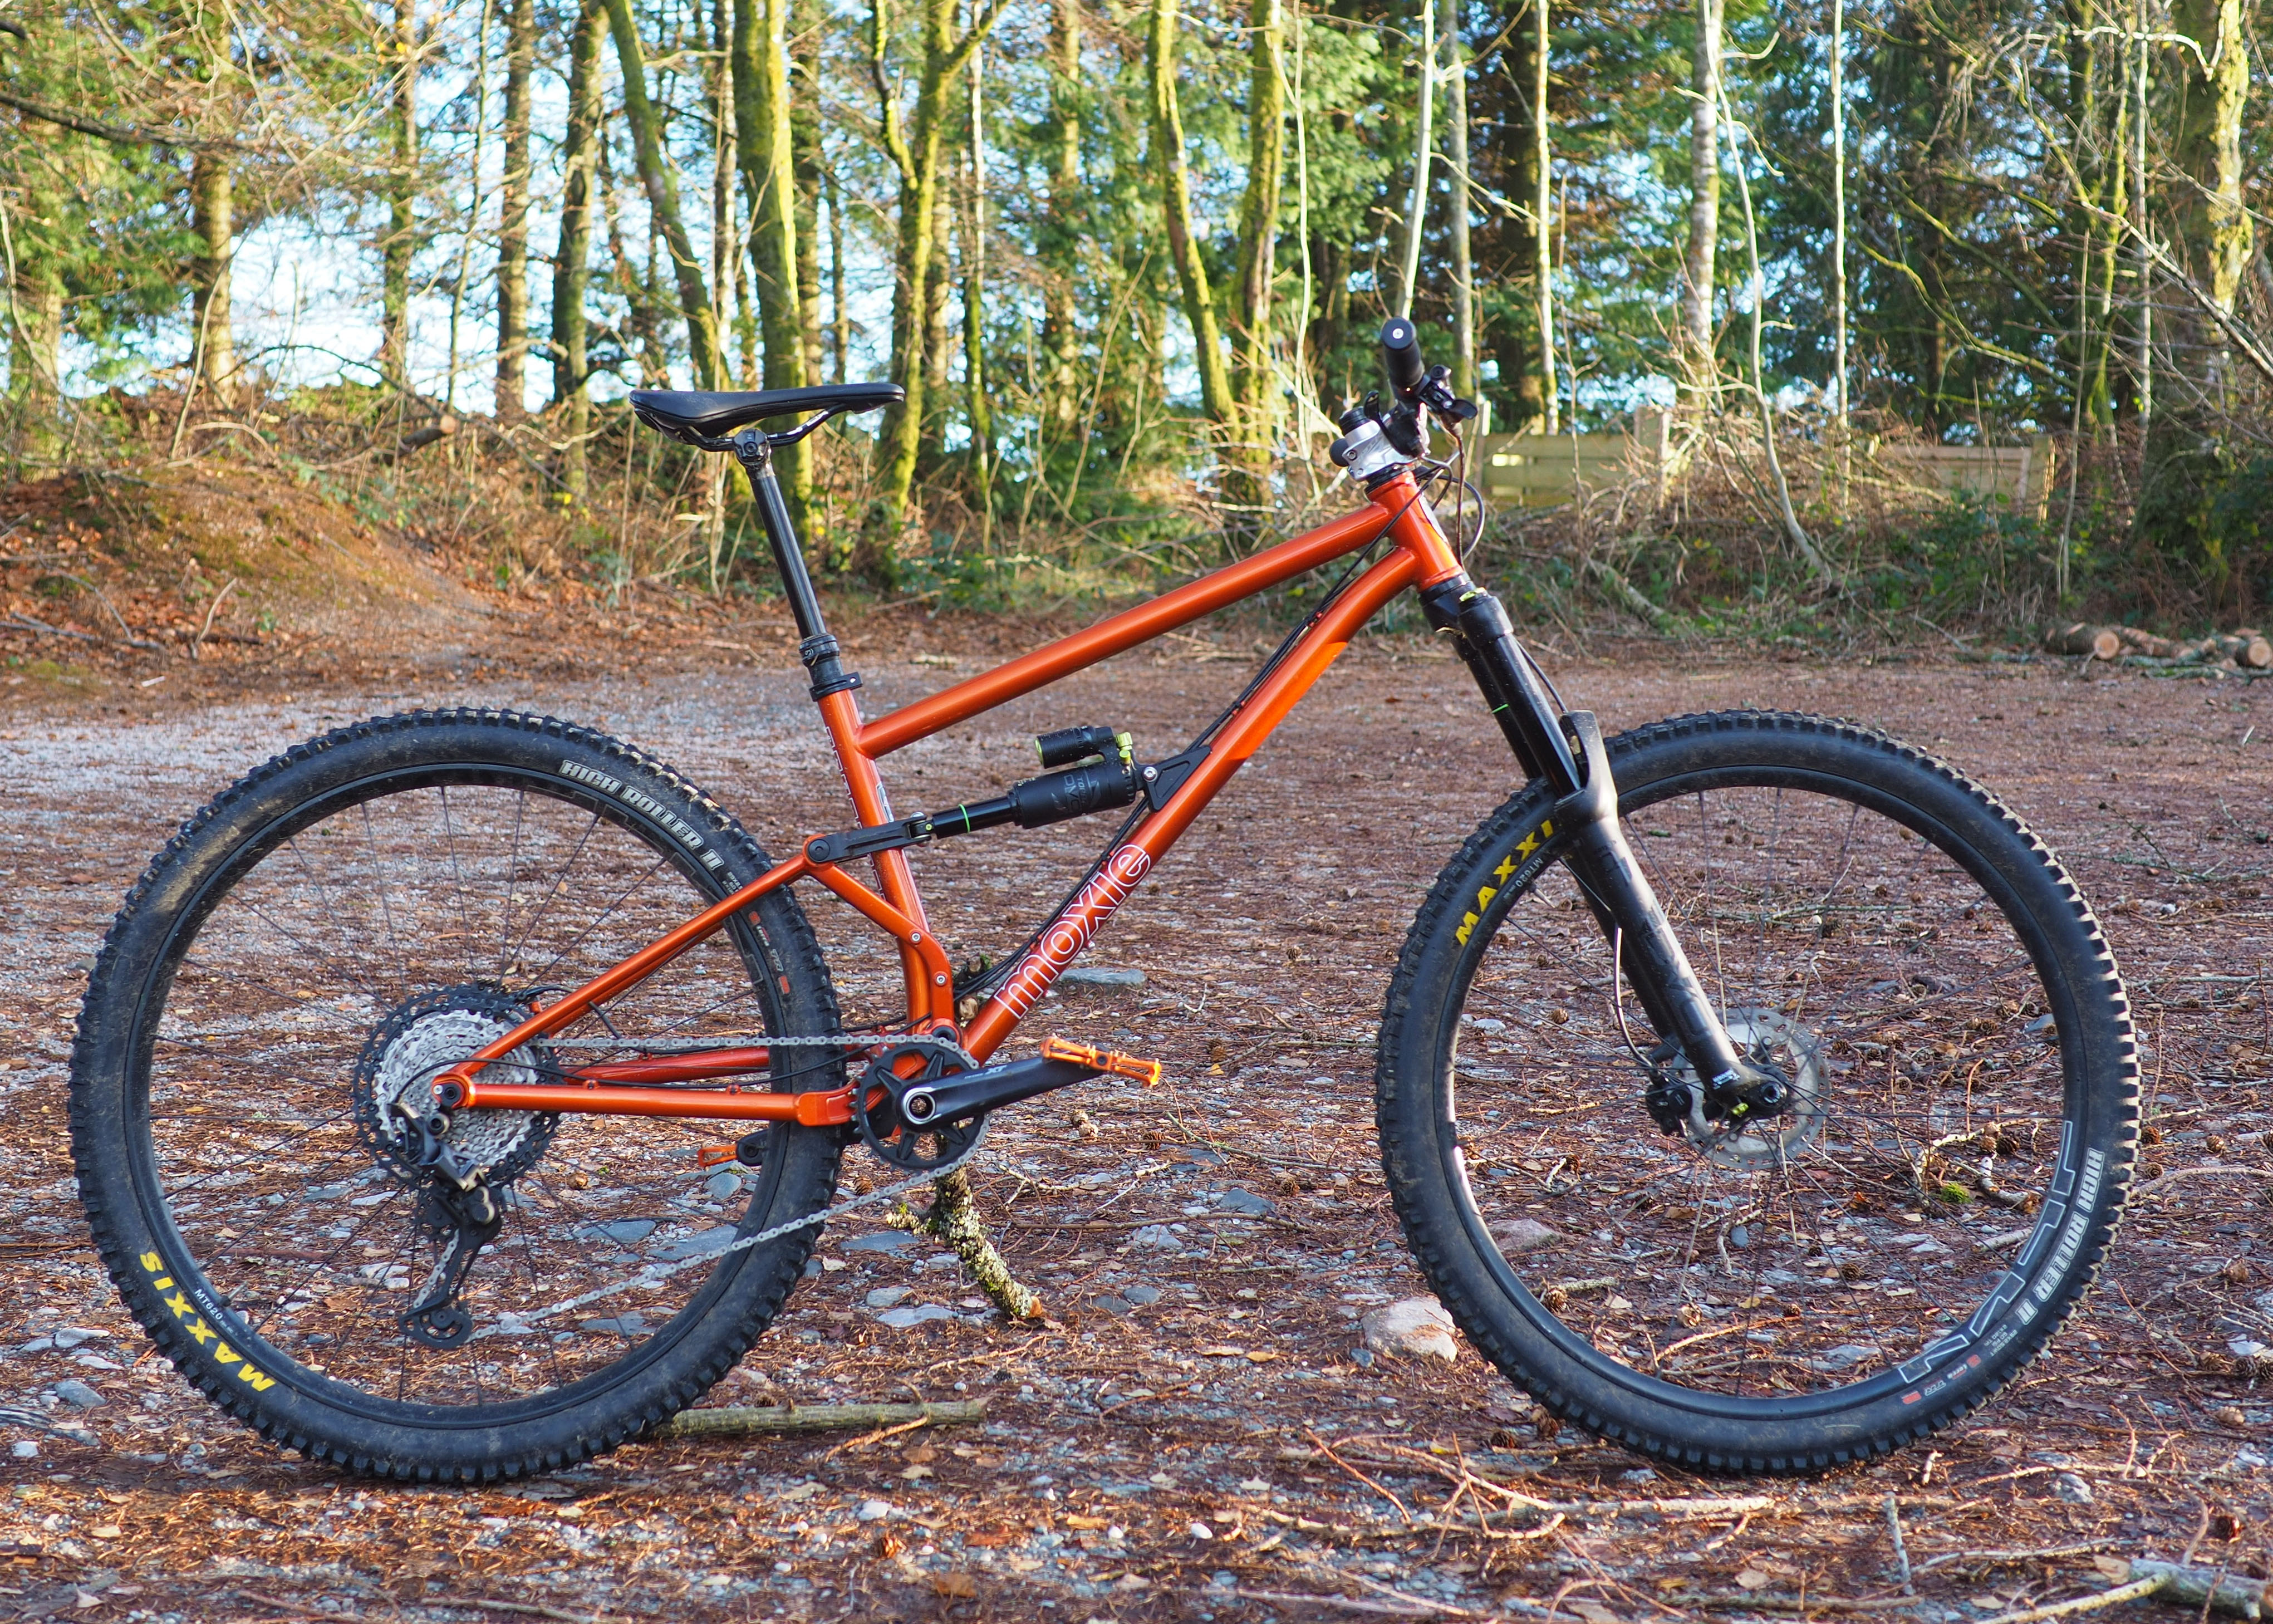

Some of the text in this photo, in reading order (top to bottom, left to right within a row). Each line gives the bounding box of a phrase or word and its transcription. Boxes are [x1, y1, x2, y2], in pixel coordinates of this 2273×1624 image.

[558, 759, 724, 871] HIGH ROLLER II
[1515, 857, 1544, 888] MT620
[994, 844, 1151, 1019] moxie
[1455, 820, 1554, 946] MAXXI
[2015, 1147, 2105, 1325] HIGH ROLLER II
[140, 1252, 276, 1392] MAXXIS
[195, 1288, 223, 1320] MT620
